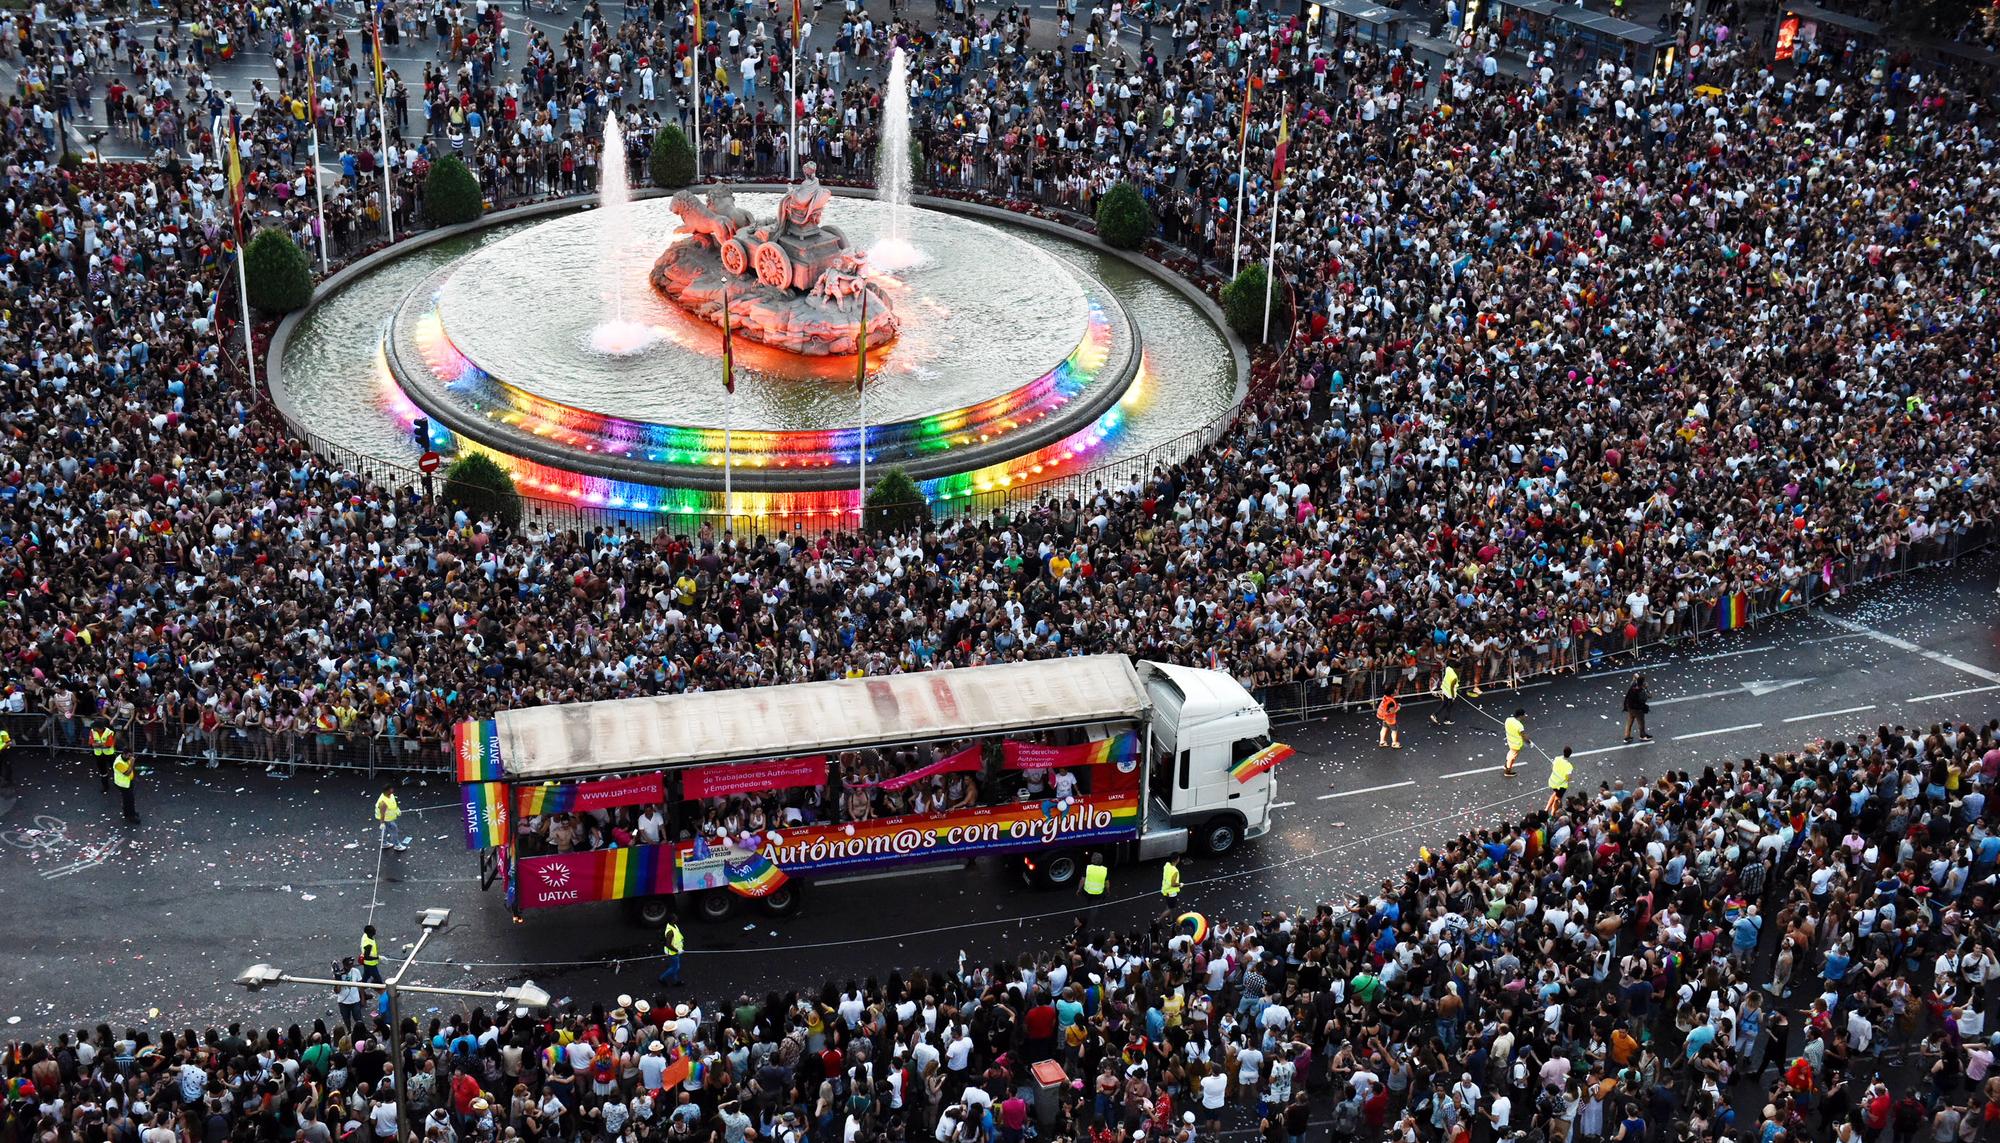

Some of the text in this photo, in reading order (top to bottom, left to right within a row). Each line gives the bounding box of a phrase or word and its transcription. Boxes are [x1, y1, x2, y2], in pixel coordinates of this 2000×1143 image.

[581, 784, 657, 800] www.uatae.org
[703, 786, 709, 794] y
[466, 802, 479, 834] UATAE
[762, 804, 1113, 865] Autónom@s con orgullo
[538, 889, 579, 902] UATAE
